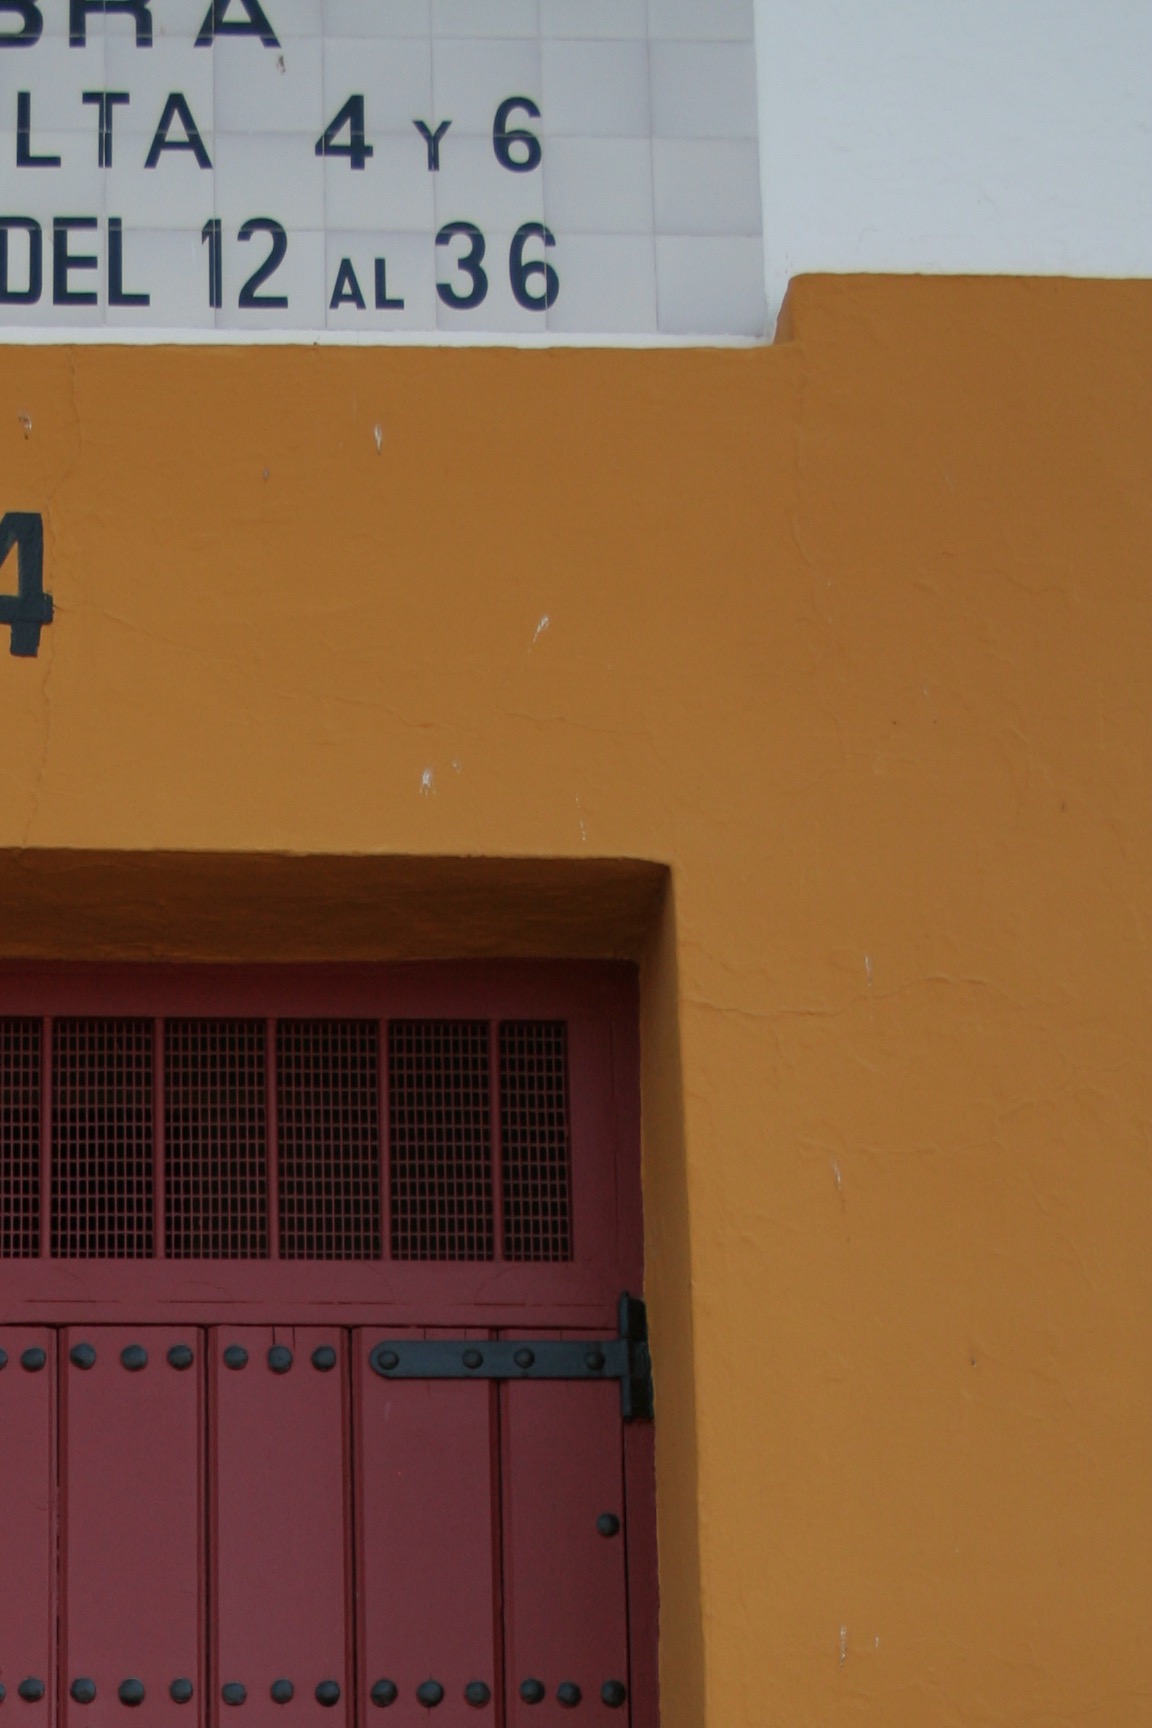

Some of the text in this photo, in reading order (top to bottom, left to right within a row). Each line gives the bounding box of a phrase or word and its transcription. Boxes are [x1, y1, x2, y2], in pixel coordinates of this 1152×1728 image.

[313, 93, 375, 171] 4
[412, 119, 453, 173] Y
[491, 95, 543, 173] 6
[200, 216, 289, 310] 12
[328, 257, 406, 310] AL
[434, 220, 561, 312] 36
